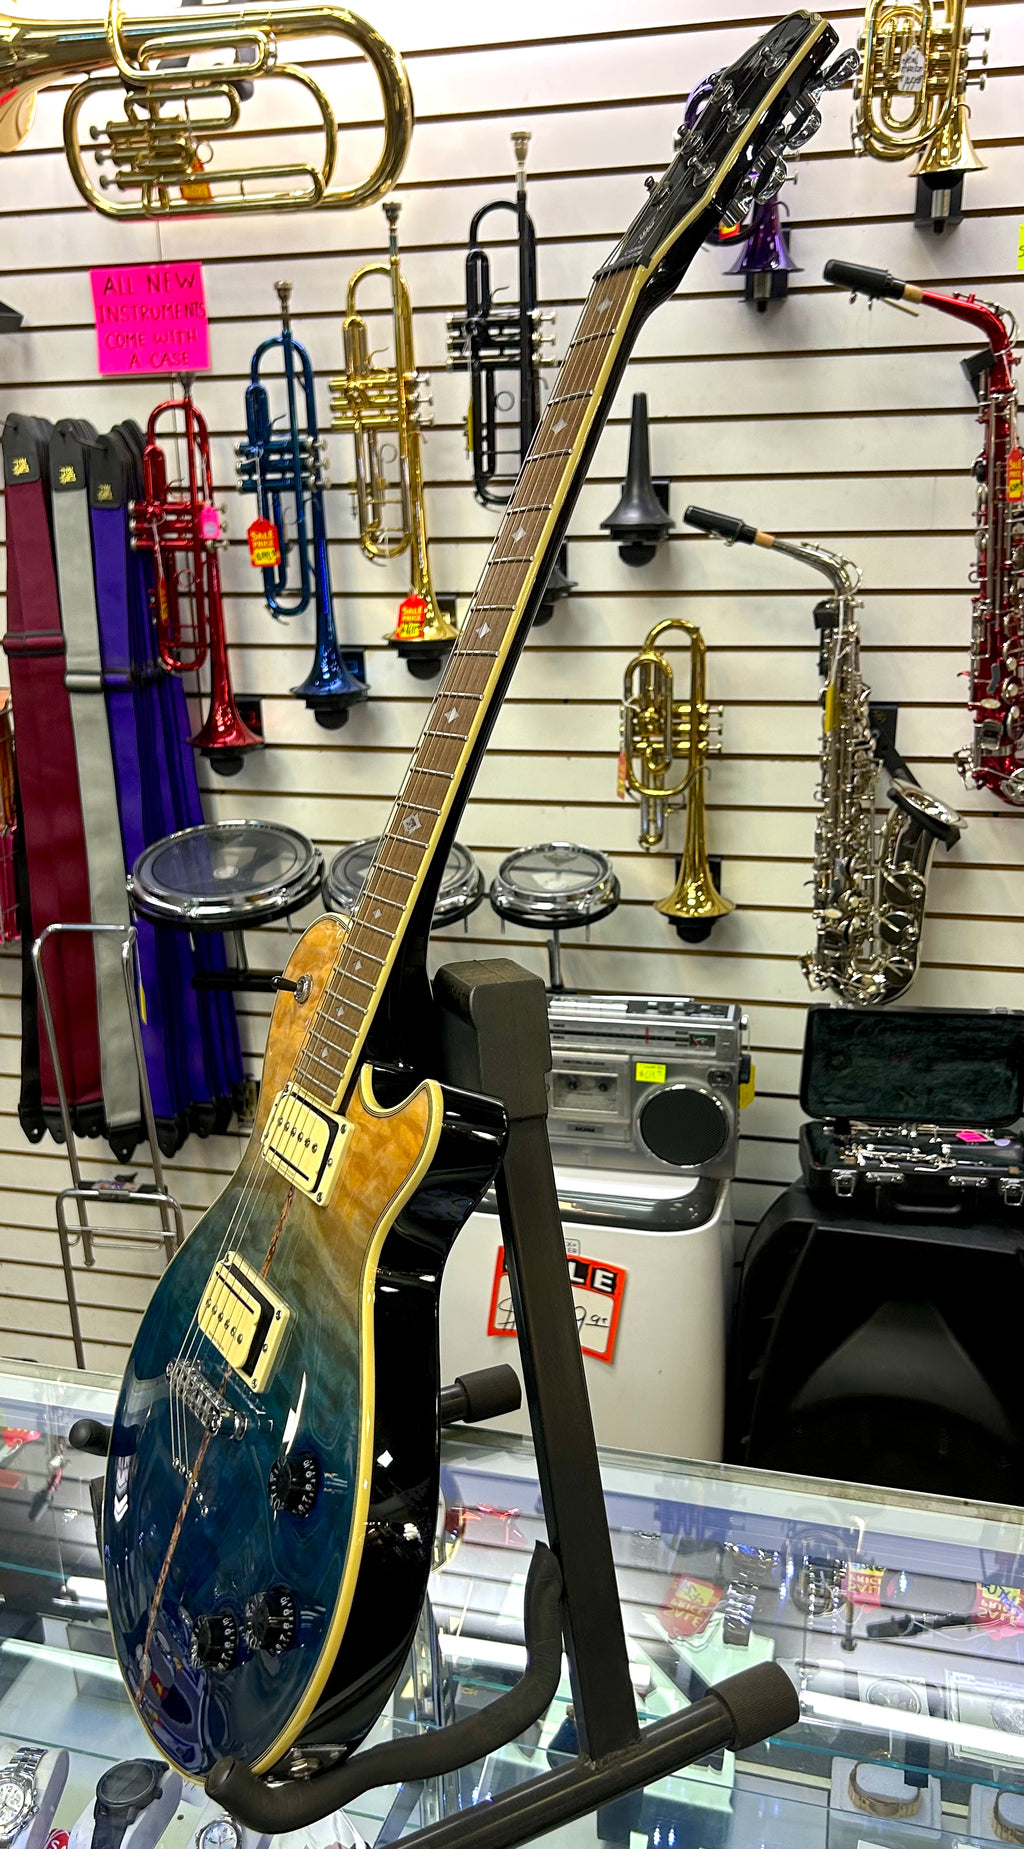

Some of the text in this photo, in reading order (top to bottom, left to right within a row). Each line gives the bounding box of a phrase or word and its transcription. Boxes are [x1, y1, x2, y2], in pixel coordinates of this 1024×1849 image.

[103, 271, 196, 296] ALL NEW
[98, 302, 206, 324] INSTRUMENTS
[105, 328, 198, 351] COME WITH
[129, 352, 191, 369] A CASE
